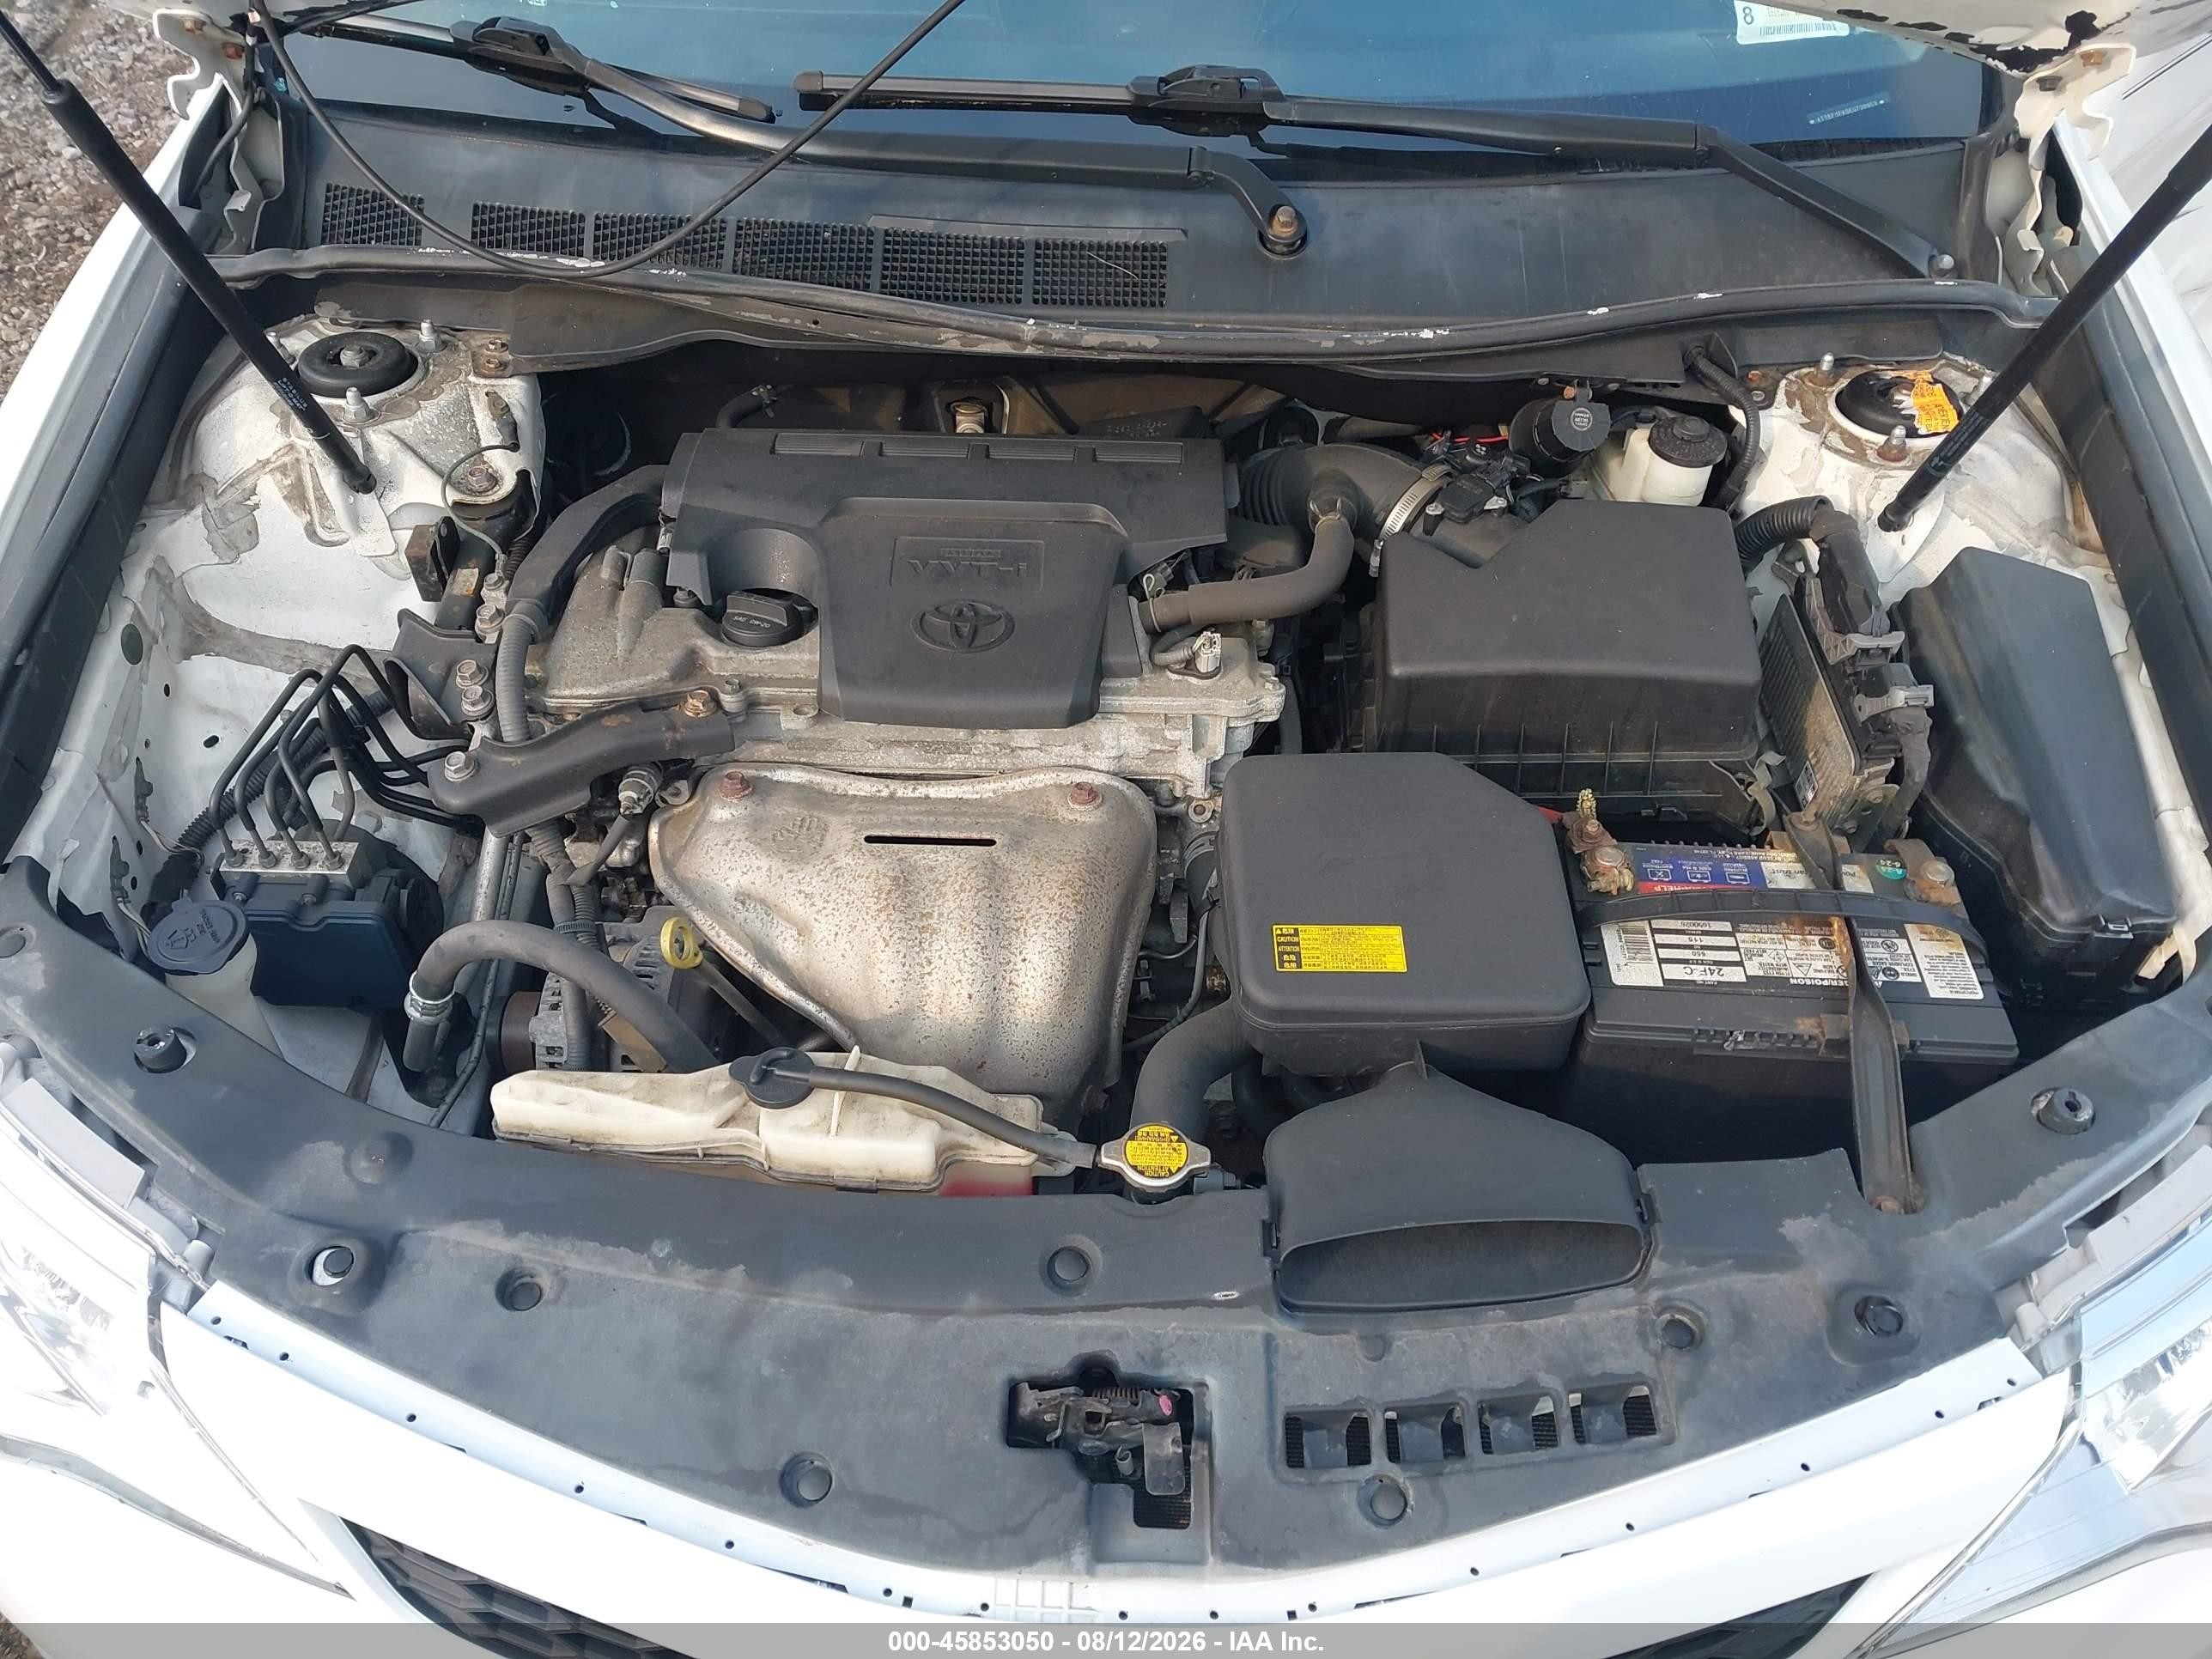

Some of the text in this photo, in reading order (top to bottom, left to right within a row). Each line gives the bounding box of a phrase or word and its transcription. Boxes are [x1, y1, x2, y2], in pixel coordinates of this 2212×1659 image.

[1742, 6, 1754, 25] 8
[1880, 859, 1901, 867] 6-24
[1683, 965, 1725, 977] 24F-C
